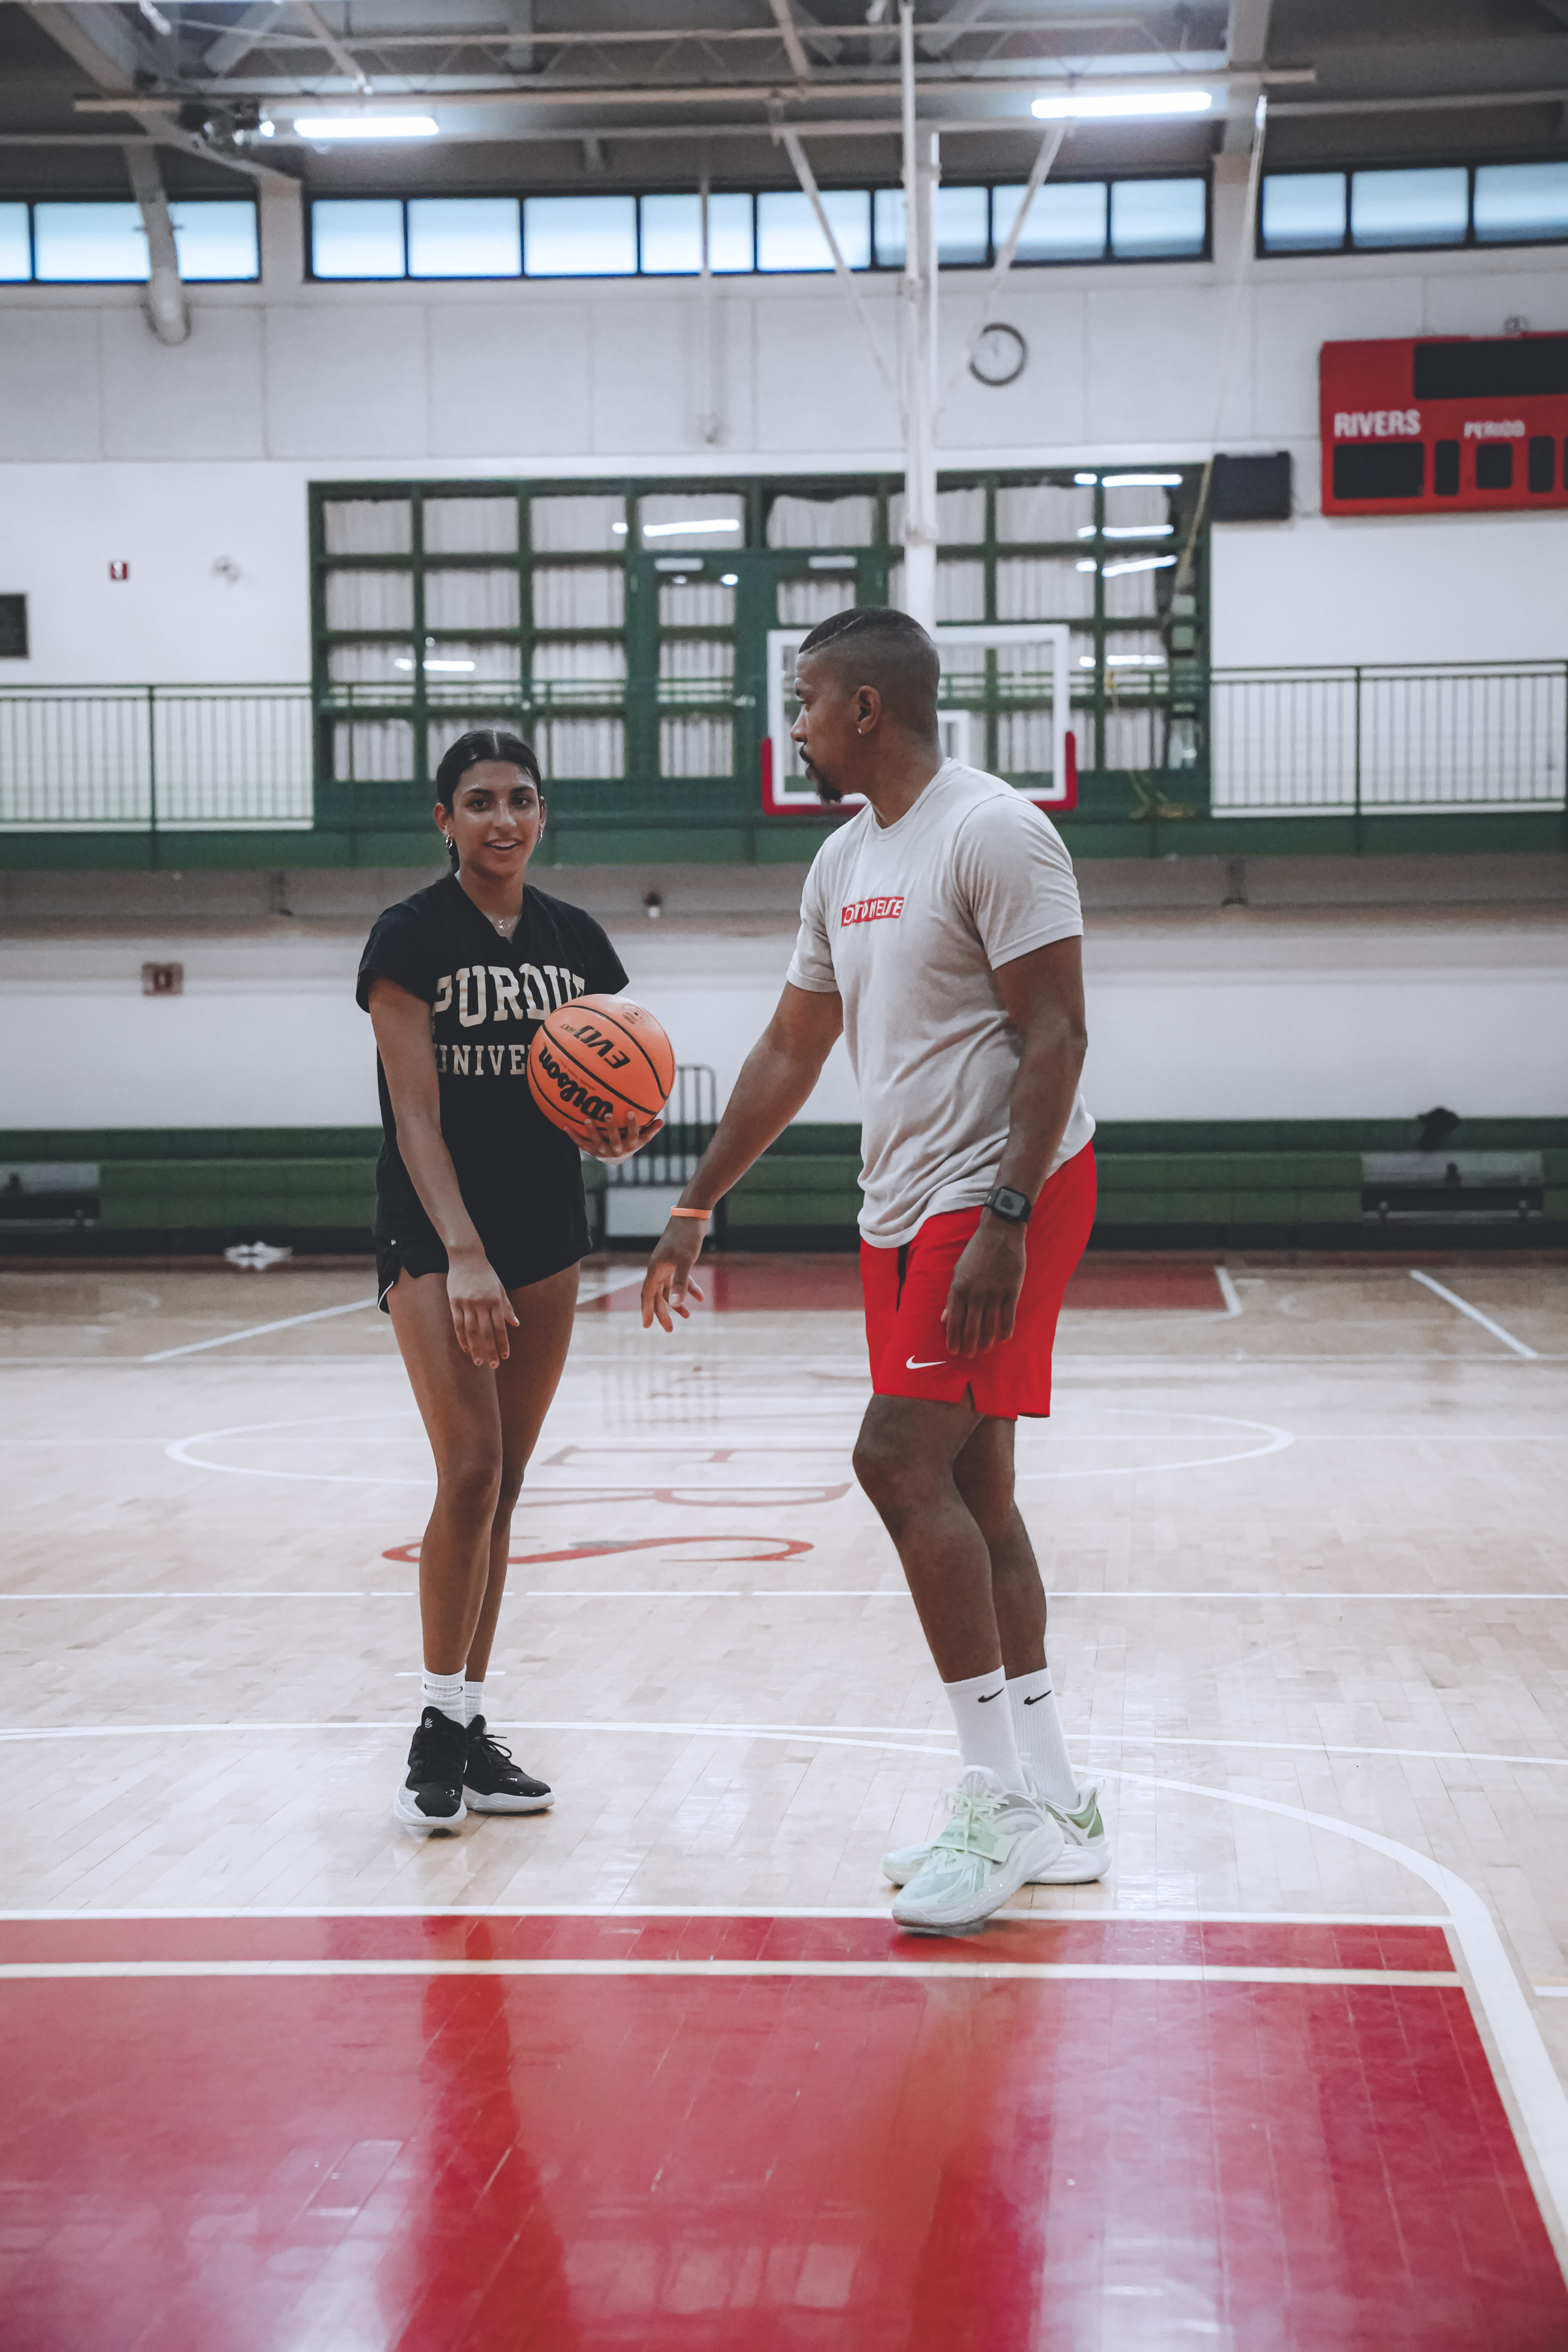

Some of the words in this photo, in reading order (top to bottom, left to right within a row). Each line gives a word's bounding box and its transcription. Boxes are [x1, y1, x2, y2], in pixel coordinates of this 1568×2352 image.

[1334, 409, 1421, 438] RIVERS
[434, 1044, 531, 1076] UNIVE
[539, 1045, 613, 1123] Wilson
